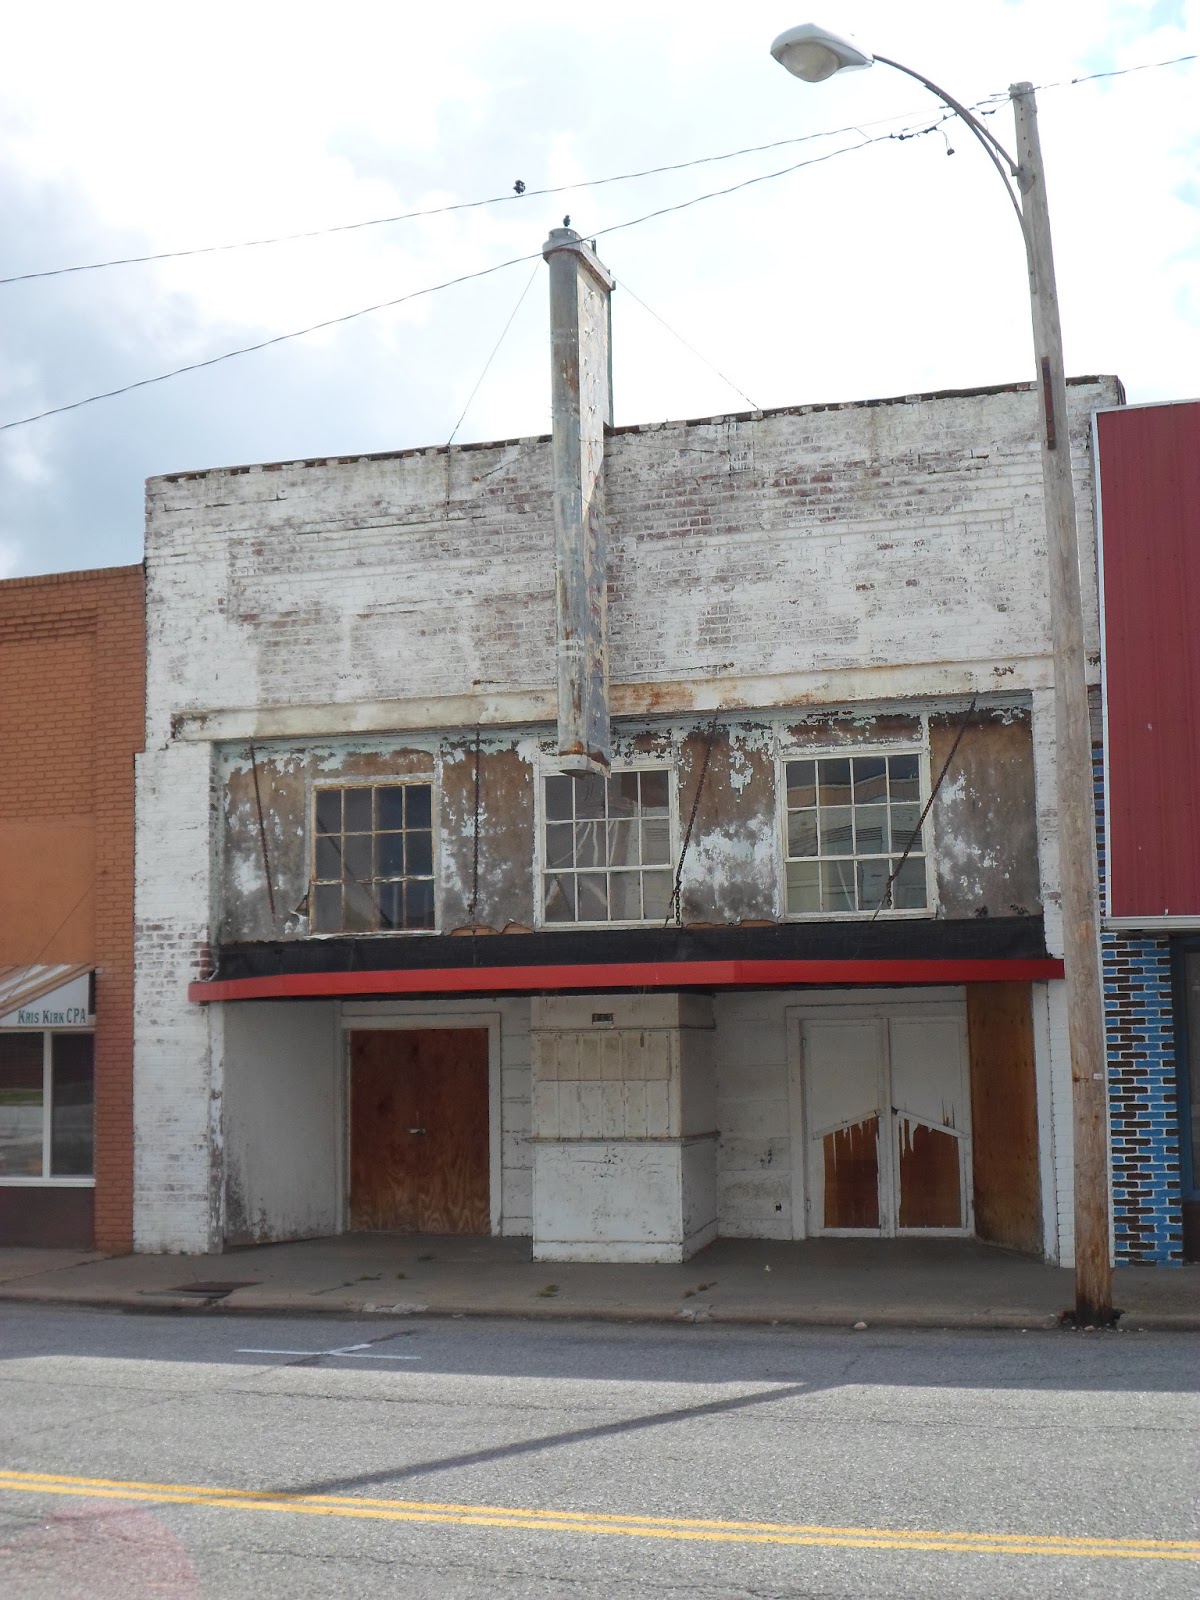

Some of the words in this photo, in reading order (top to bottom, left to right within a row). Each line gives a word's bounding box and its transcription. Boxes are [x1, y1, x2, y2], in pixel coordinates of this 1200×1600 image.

[17, 1009, 40, 1024] KRIS
[42, 1009, 65, 1024] KIRK
[66, 1007, 86, 1023] CPA
